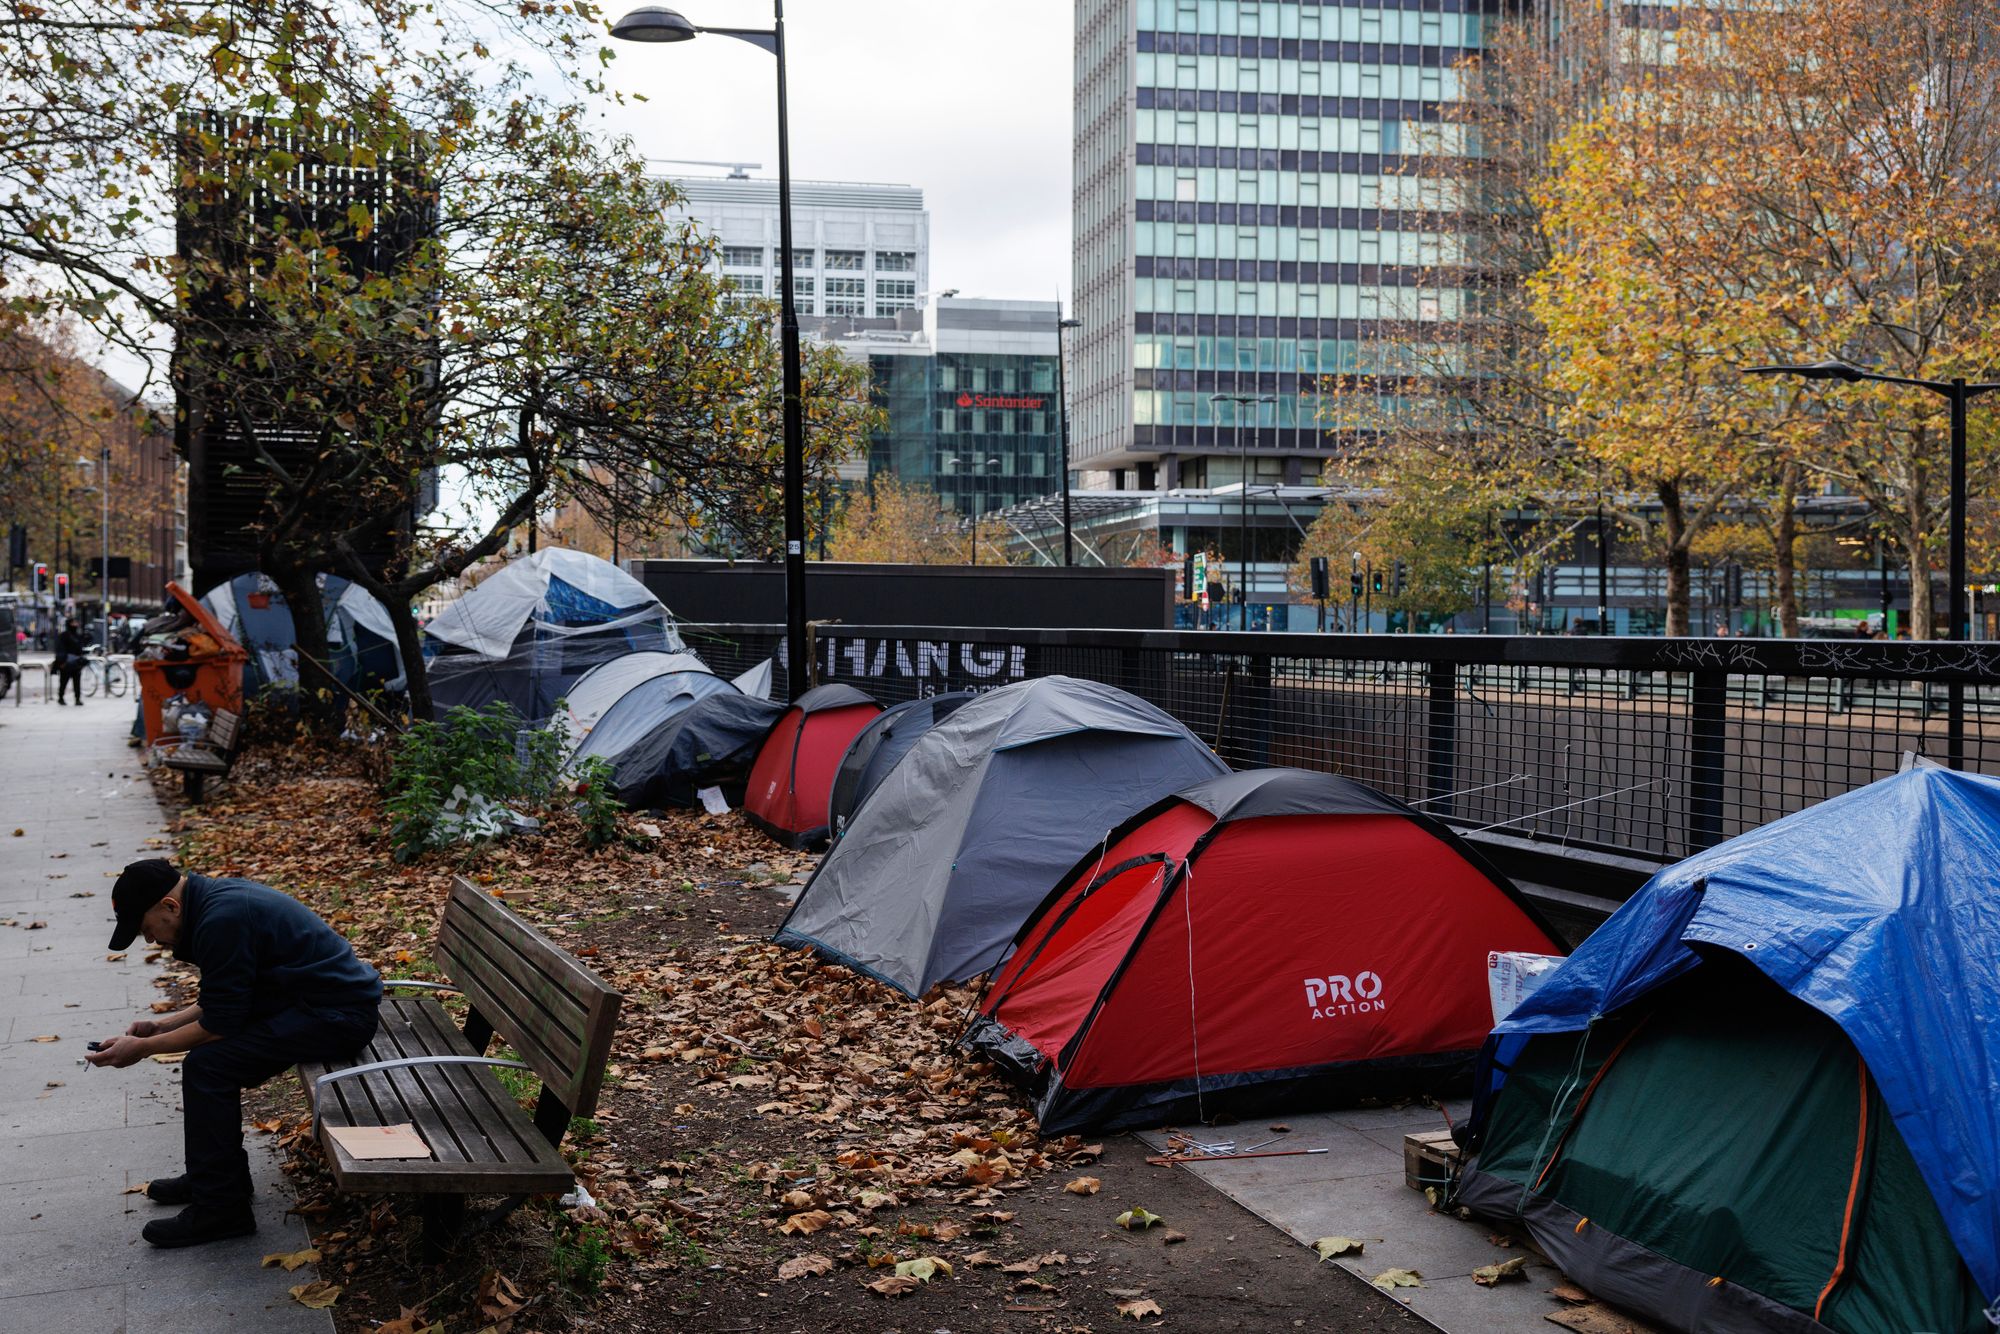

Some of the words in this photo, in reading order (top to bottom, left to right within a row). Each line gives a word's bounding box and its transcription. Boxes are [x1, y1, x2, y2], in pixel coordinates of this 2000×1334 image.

[975, 394, 1044, 409] Santander
[1303, 971, 1383, 1008] PRO
[1311, 999, 1386, 1020] ACTION
